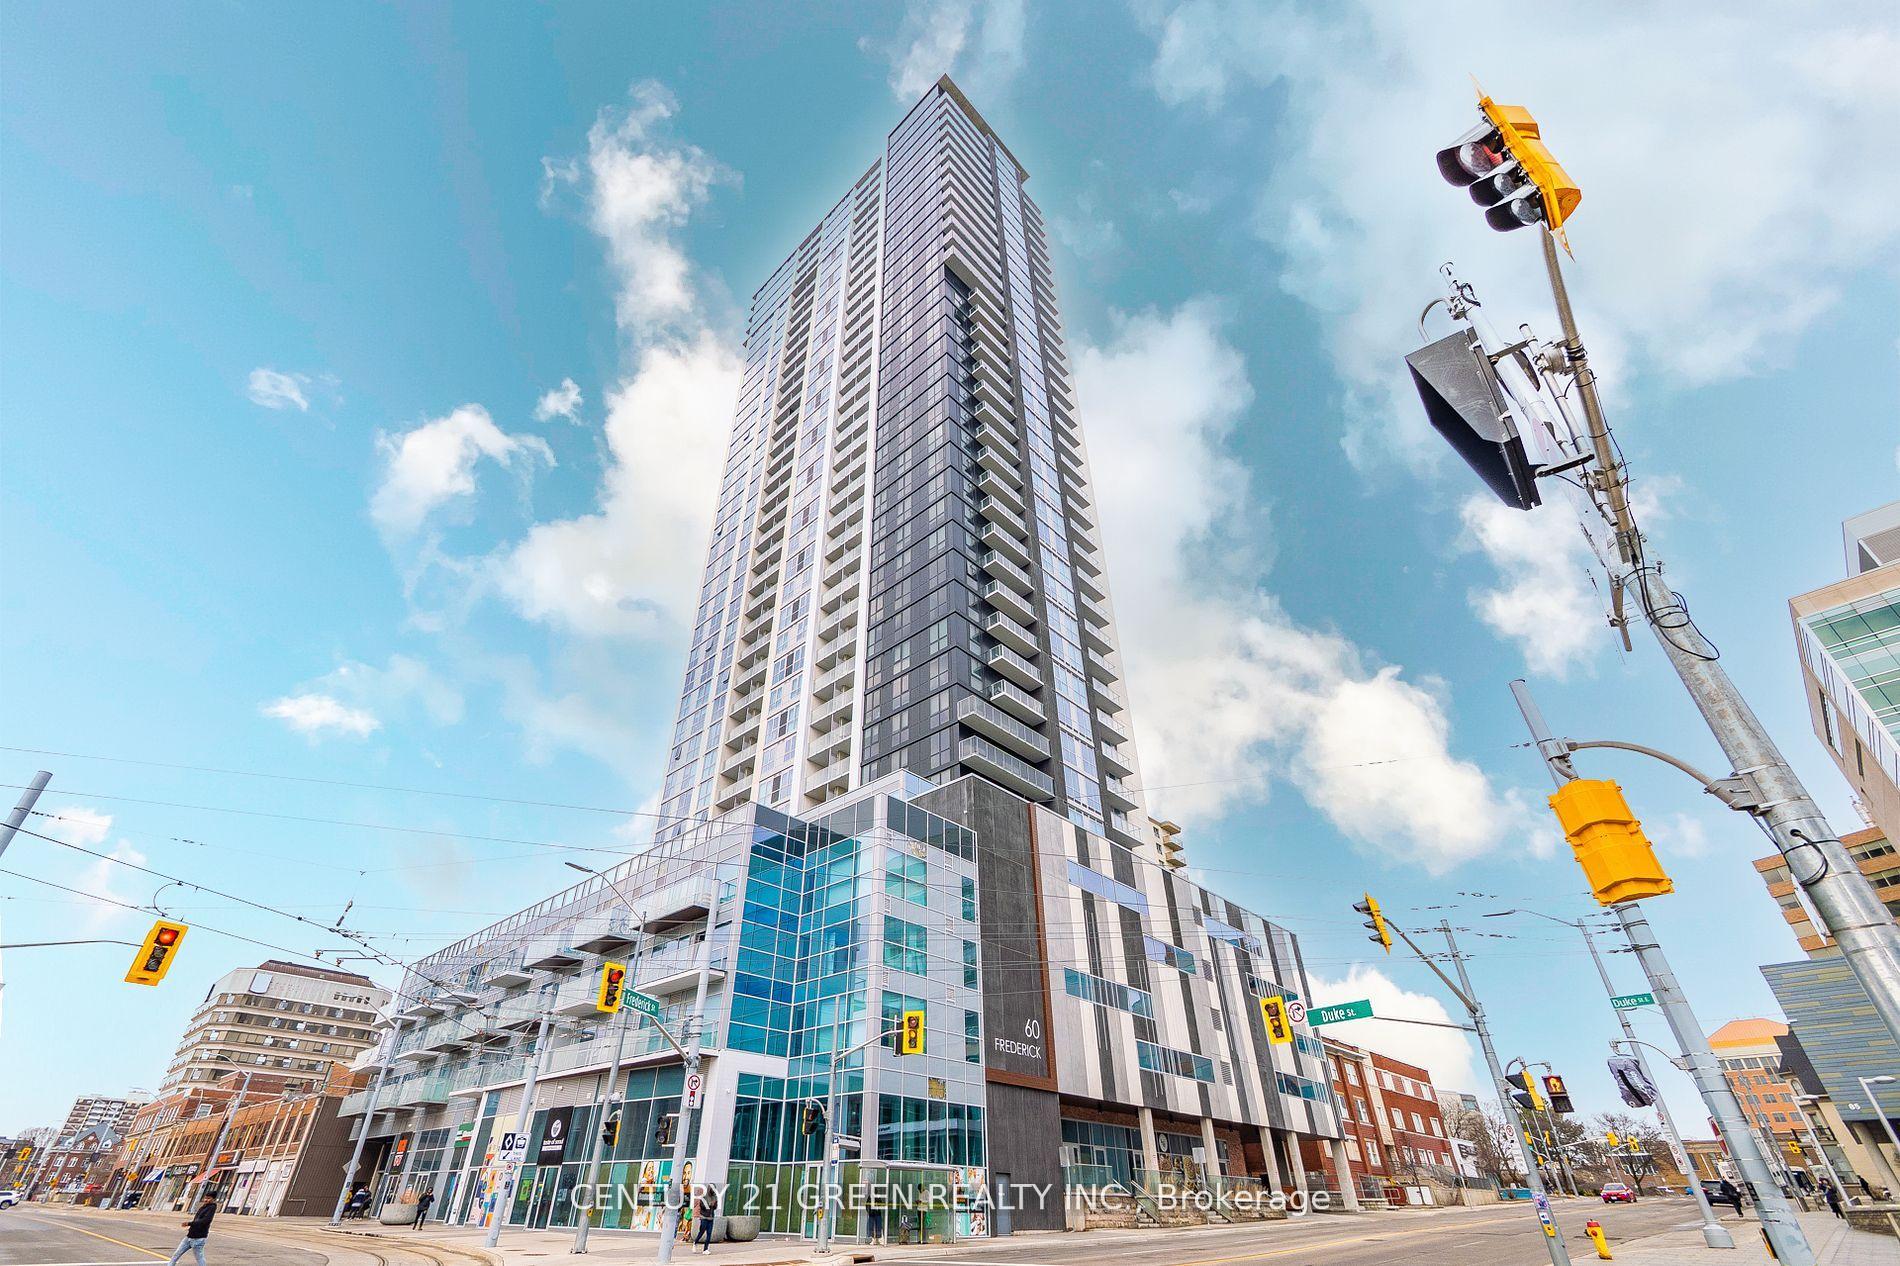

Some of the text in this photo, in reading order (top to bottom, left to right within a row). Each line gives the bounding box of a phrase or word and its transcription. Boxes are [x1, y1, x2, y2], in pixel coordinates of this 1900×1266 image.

[626, 993, 651, 1011] Frederick
[1612, 998, 1637, 1007] Duke
[1321, 1008, 1345, 1022] Duke
[1024, 1018, 1040, 1039] 60
[994, 1037, 1042, 1060] FREDERICK
